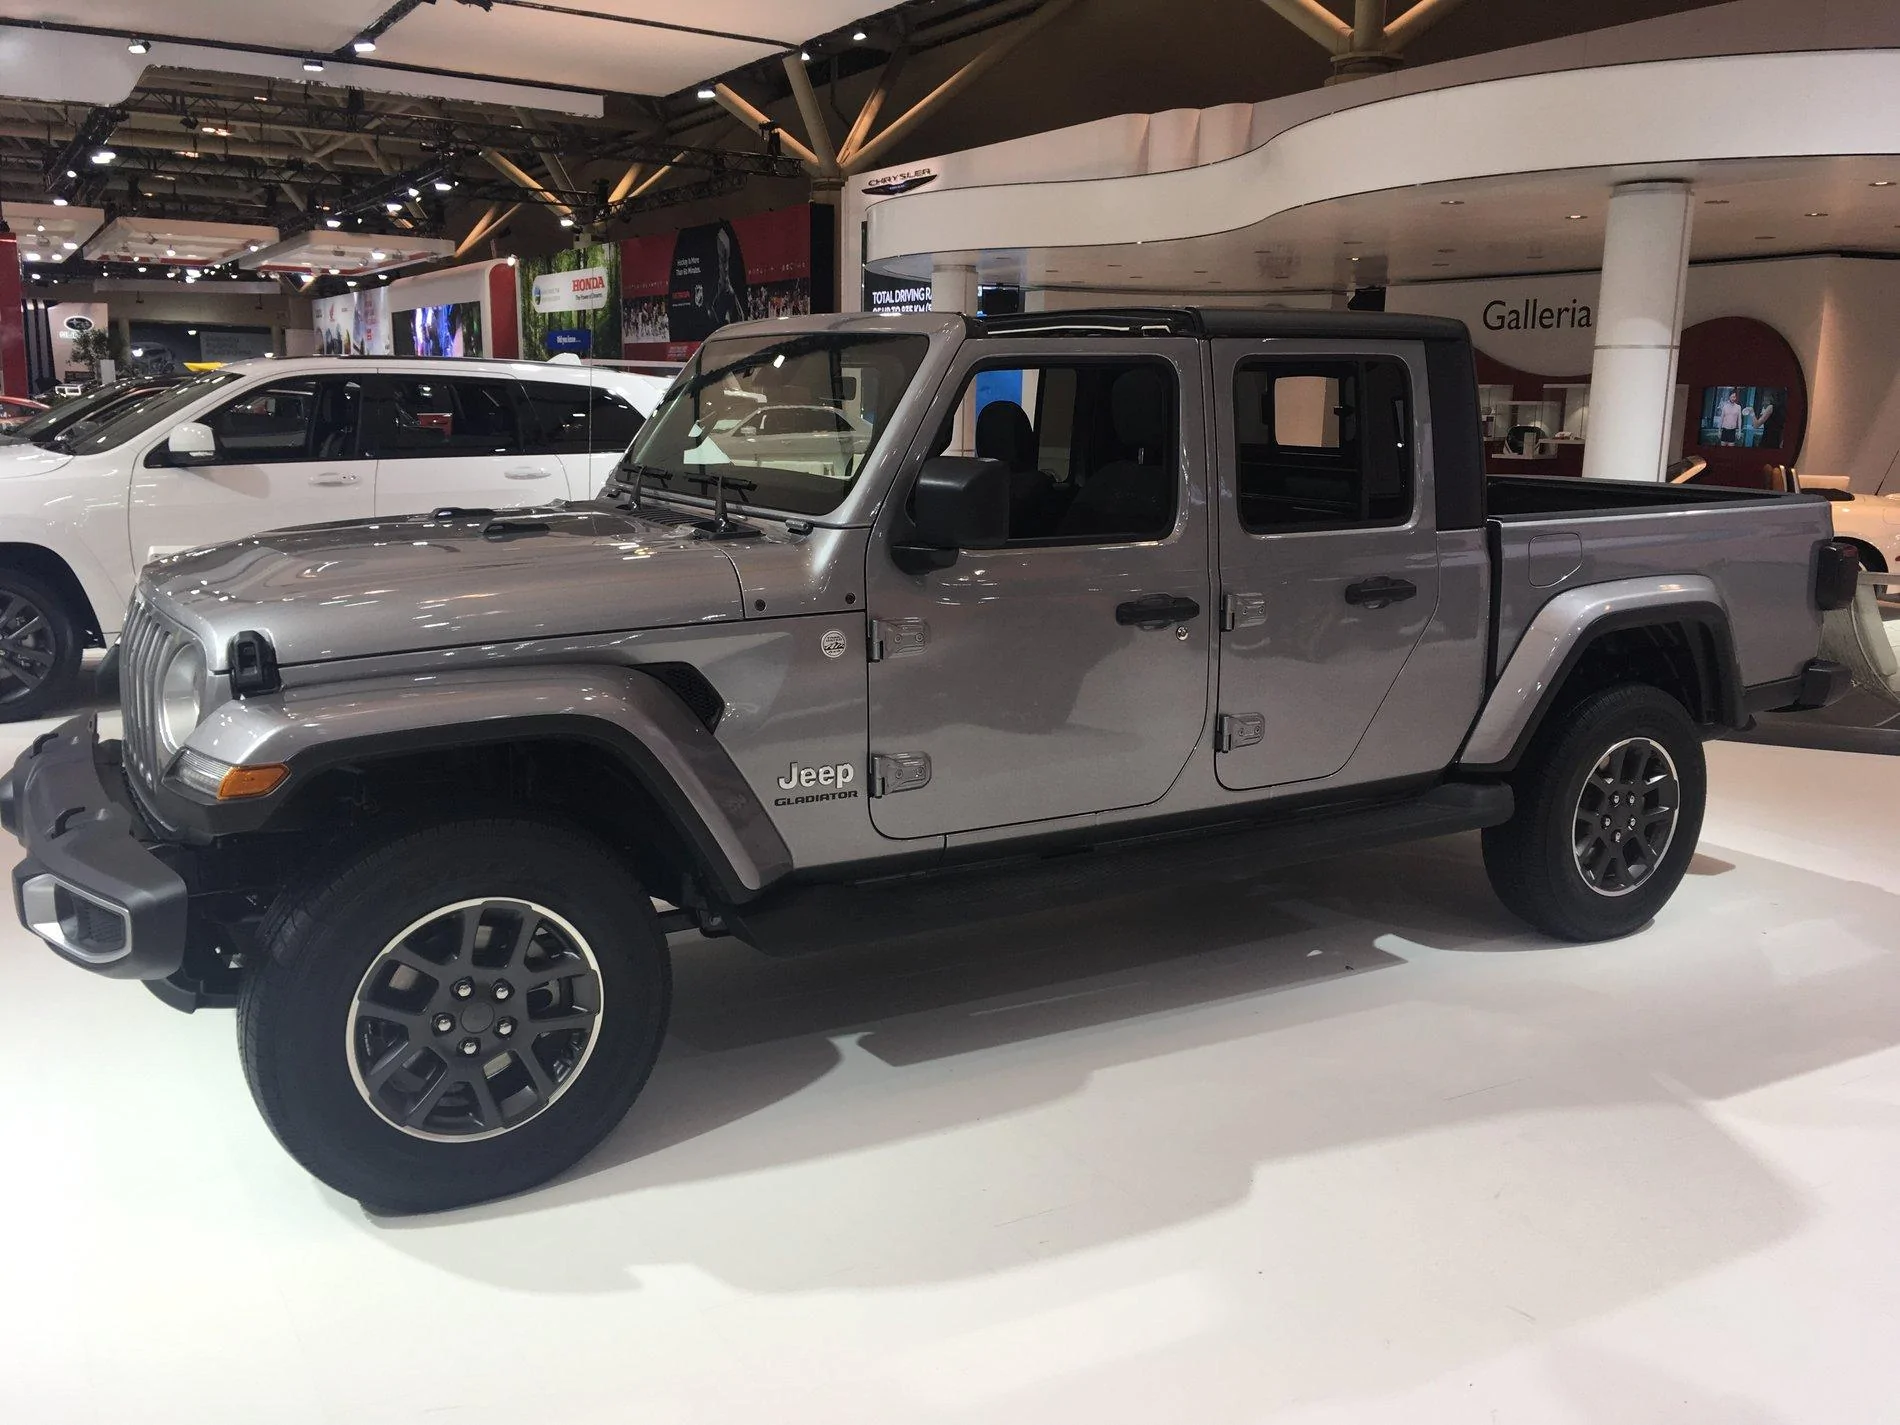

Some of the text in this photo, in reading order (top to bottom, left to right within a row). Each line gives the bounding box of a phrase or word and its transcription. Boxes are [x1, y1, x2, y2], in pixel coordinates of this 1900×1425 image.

[868, 168, 931, 186] CHRYSLER
[572, 276, 605, 292] HONDA
[872, 290, 894, 305] TOTAL
[894, 287, 925, 303] DRIVING
[1482, 298, 1593, 331] Galleria
[777, 761, 854, 790] Jeep
[774, 789, 859, 807] GLADIATOR
